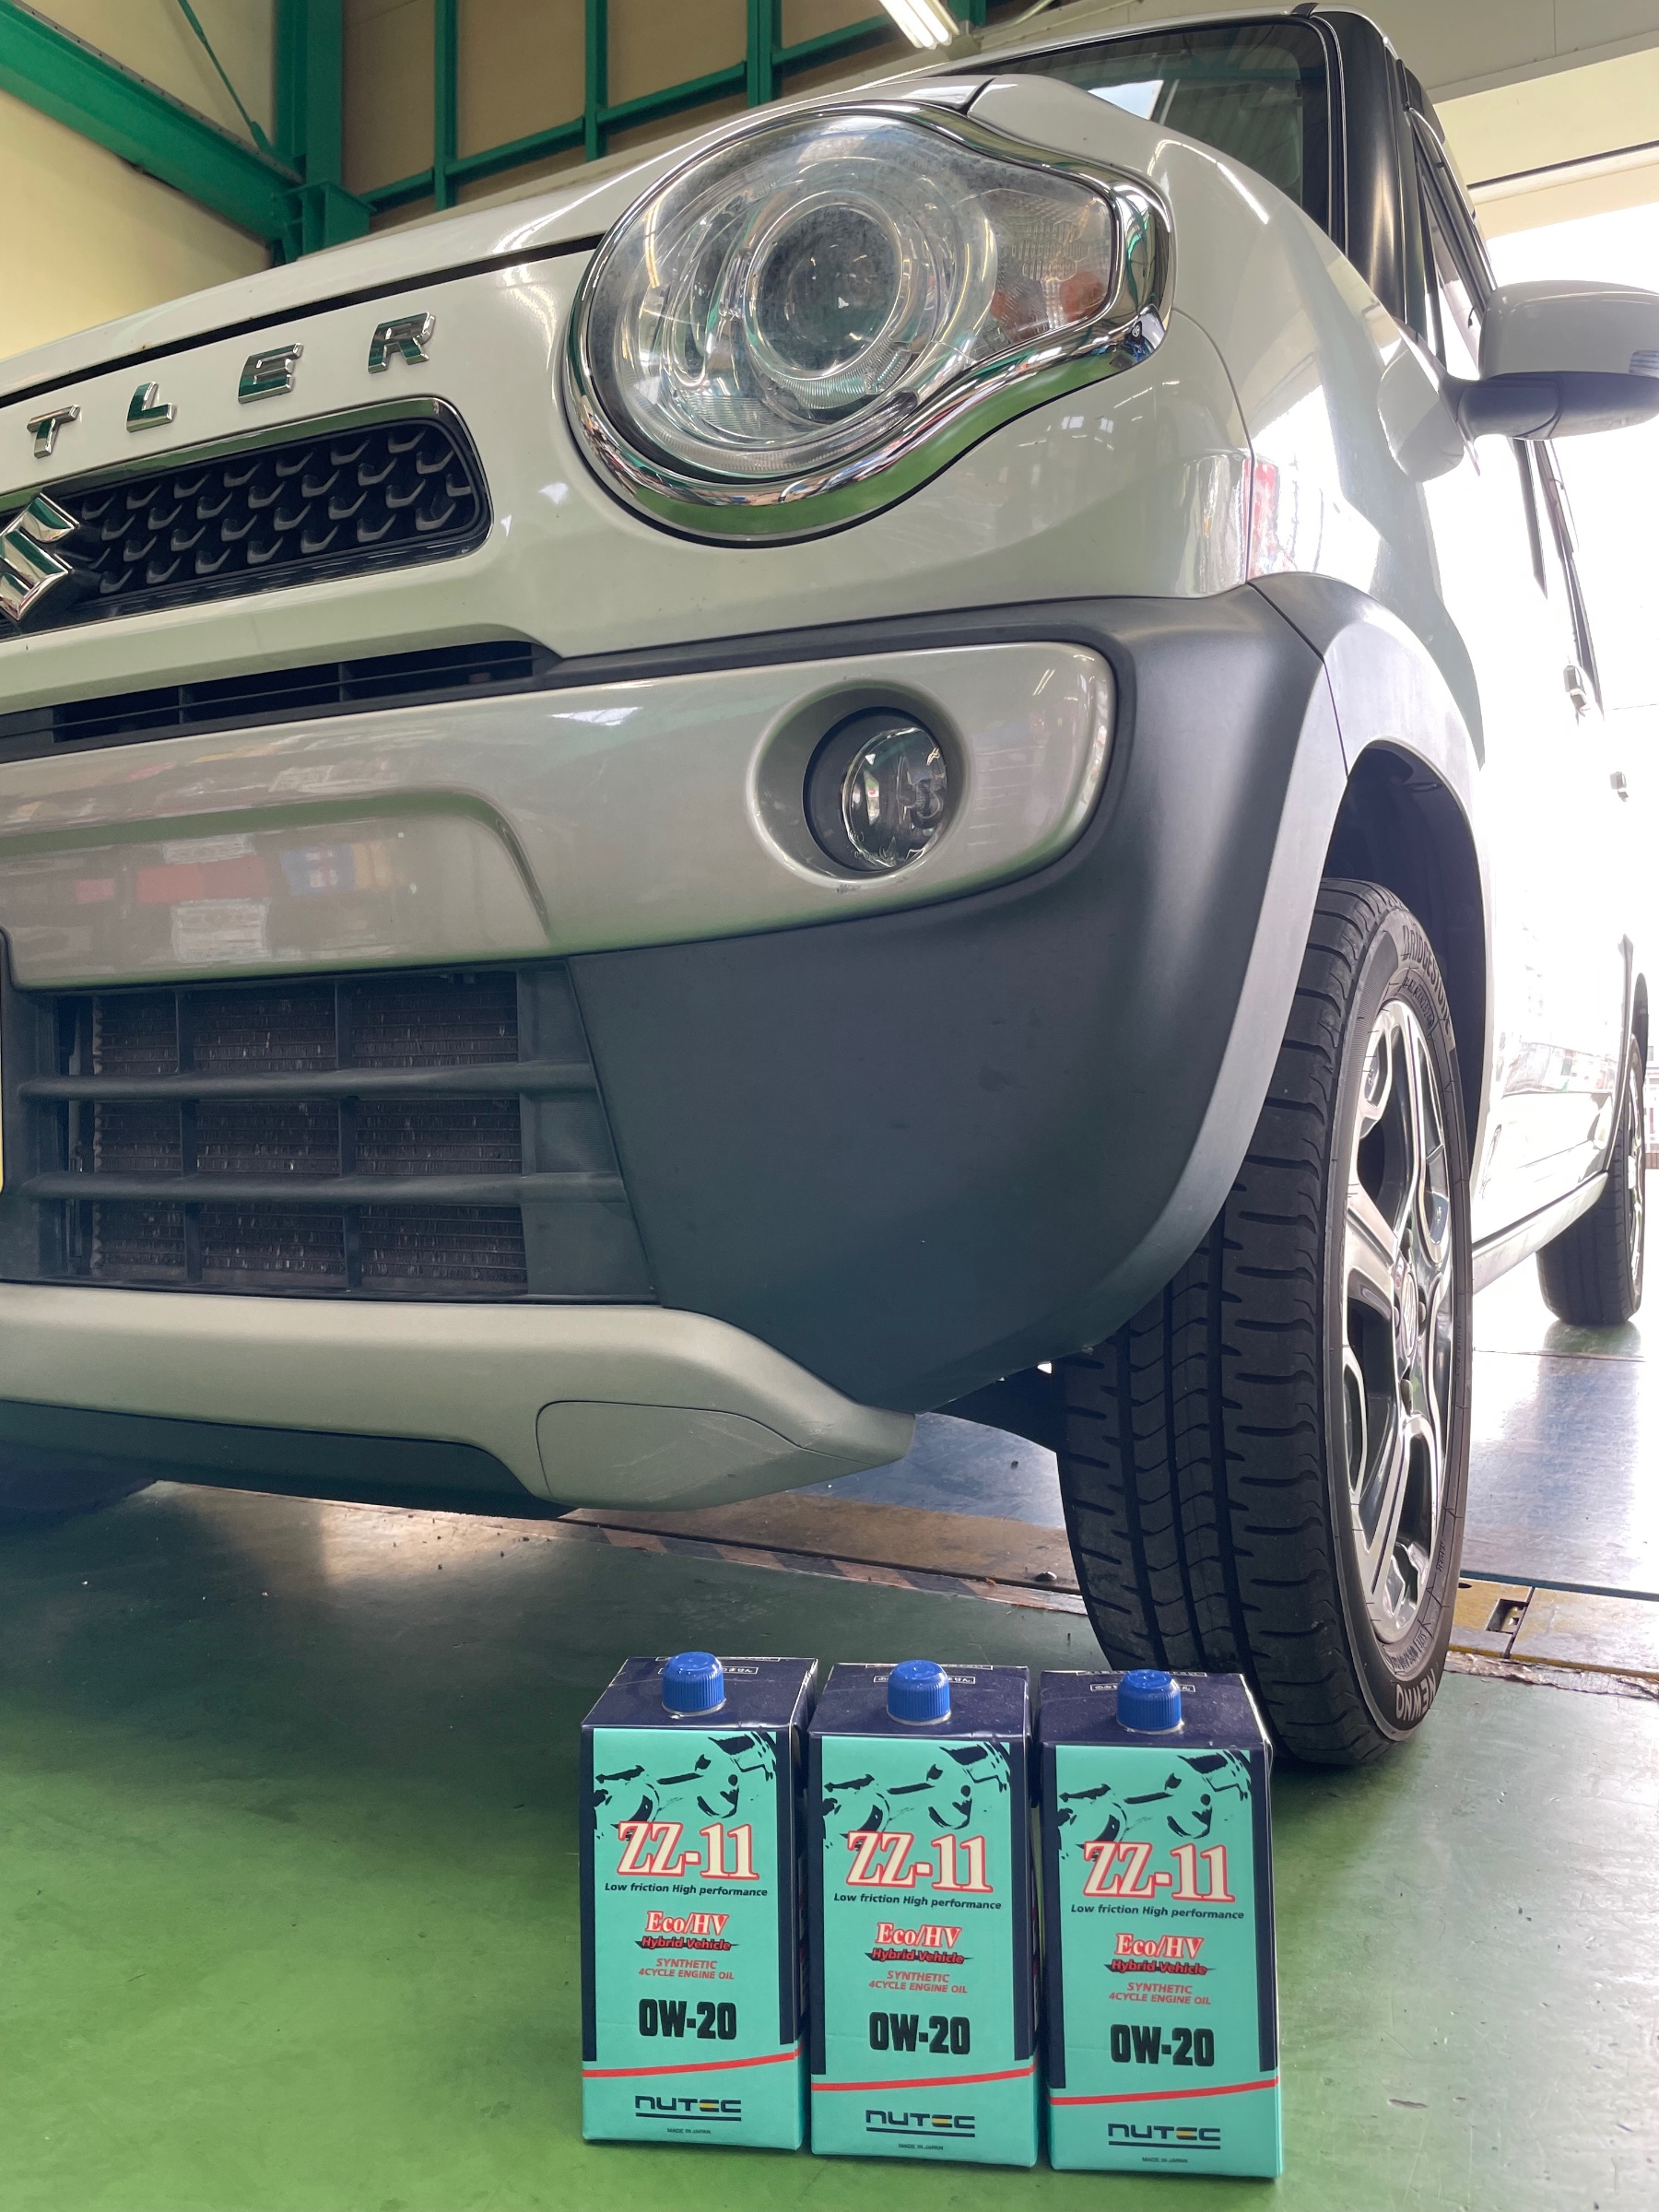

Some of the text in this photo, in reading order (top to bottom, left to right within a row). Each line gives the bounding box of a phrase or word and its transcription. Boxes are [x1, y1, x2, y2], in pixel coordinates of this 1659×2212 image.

[1395, 1668, 1438, 1722] NEWNO
[617, 1820, 760, 1880] ZZ-11
[846, 1830, 994, 1893] ZZ-11
[1083, 1841, 1236, 1903] ZZ-11
[605, 1883, 768, 1896] Low friction High performance
[833, 1893, 1002, 1910] Low friction High performance
[1071, 1904, 1244, 1919] Low friction High performance
[645, 1911, 729, 1936] Eco/HV
[641, 1936, 731, 1950] Hybrid Vehicle
[875, 1923, 962, 1948] Eco/HV
[1114, 1933, 1205, 1959] Eco/HV
[655, 1958, 717, 1969] SYNTHETIC
[872, 1948, 965, 1964] Hybrid Vehicle
[638, 1968, 735, 1980] 4CYCLE ENGINE OIL
[1112, 1959, 1207, 1976] Hybrid Vehicle
[887, 1971, 950, 1983] SYNTHETIC
[868, 1981, 968, 1994] 4CYCLE ENGINE OIL
[1127, 1982, 1193, 1994] SYNTHETIC
[1109, 1993, 1211, 2006] 4CYCLE ENGINE OIL
[639, 1998, 737, 2040] 0W-20
[869, 2011, 971, 2054] 0W-20
[1110, 2024, 1215, 2067] 0W-20
[634, 2095, 742, 2113] NUTEC
[865, 2110, 975, 2129] NUTEC
[1108, 2123, 1221, 2142] NUTEC
